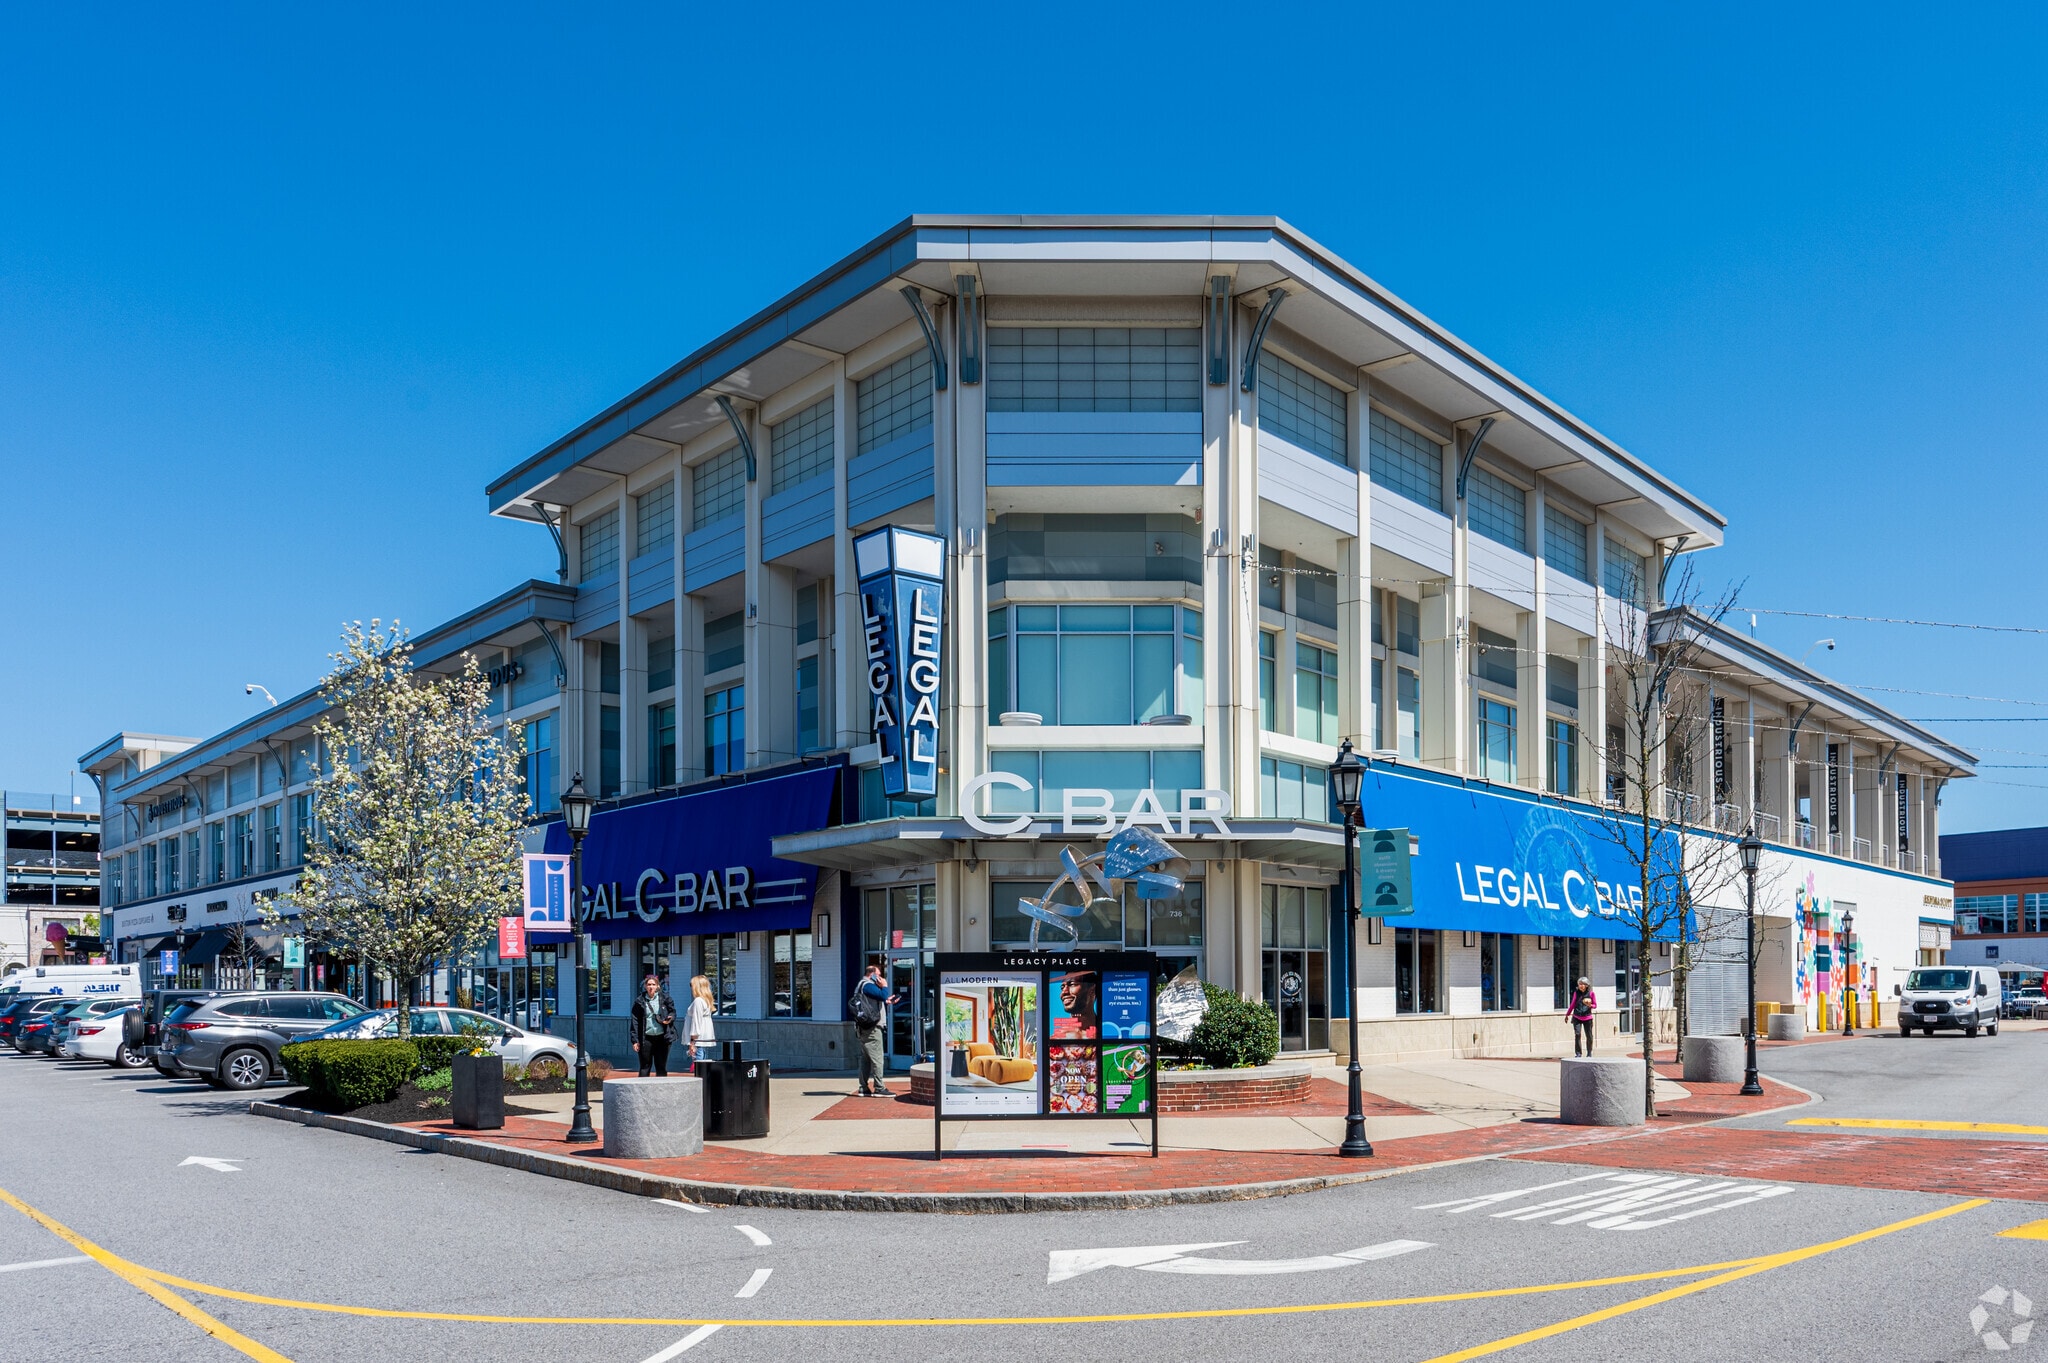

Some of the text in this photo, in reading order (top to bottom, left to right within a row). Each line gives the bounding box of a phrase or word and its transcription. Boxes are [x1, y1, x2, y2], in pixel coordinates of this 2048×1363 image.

[861, 592, 895, 764] LEGAL
[909, 588, 940, 764] LEGAL
[1714, 707, 1723, 784] INDUSTRIOUS
[960, 771, 1232, 835] C BAR
[1829, 752, 1837, 816] INDUSTRIOUS
[1898, 779, 1906, 837] INDUSTRIOUS
[571, 866, 750, 923] GAL C BAR
[1455, 862, 1560, 910] LEGAL
[1562, 870, 1589, 918] C
[1060, 1075, 1087, 1083] OPEN
